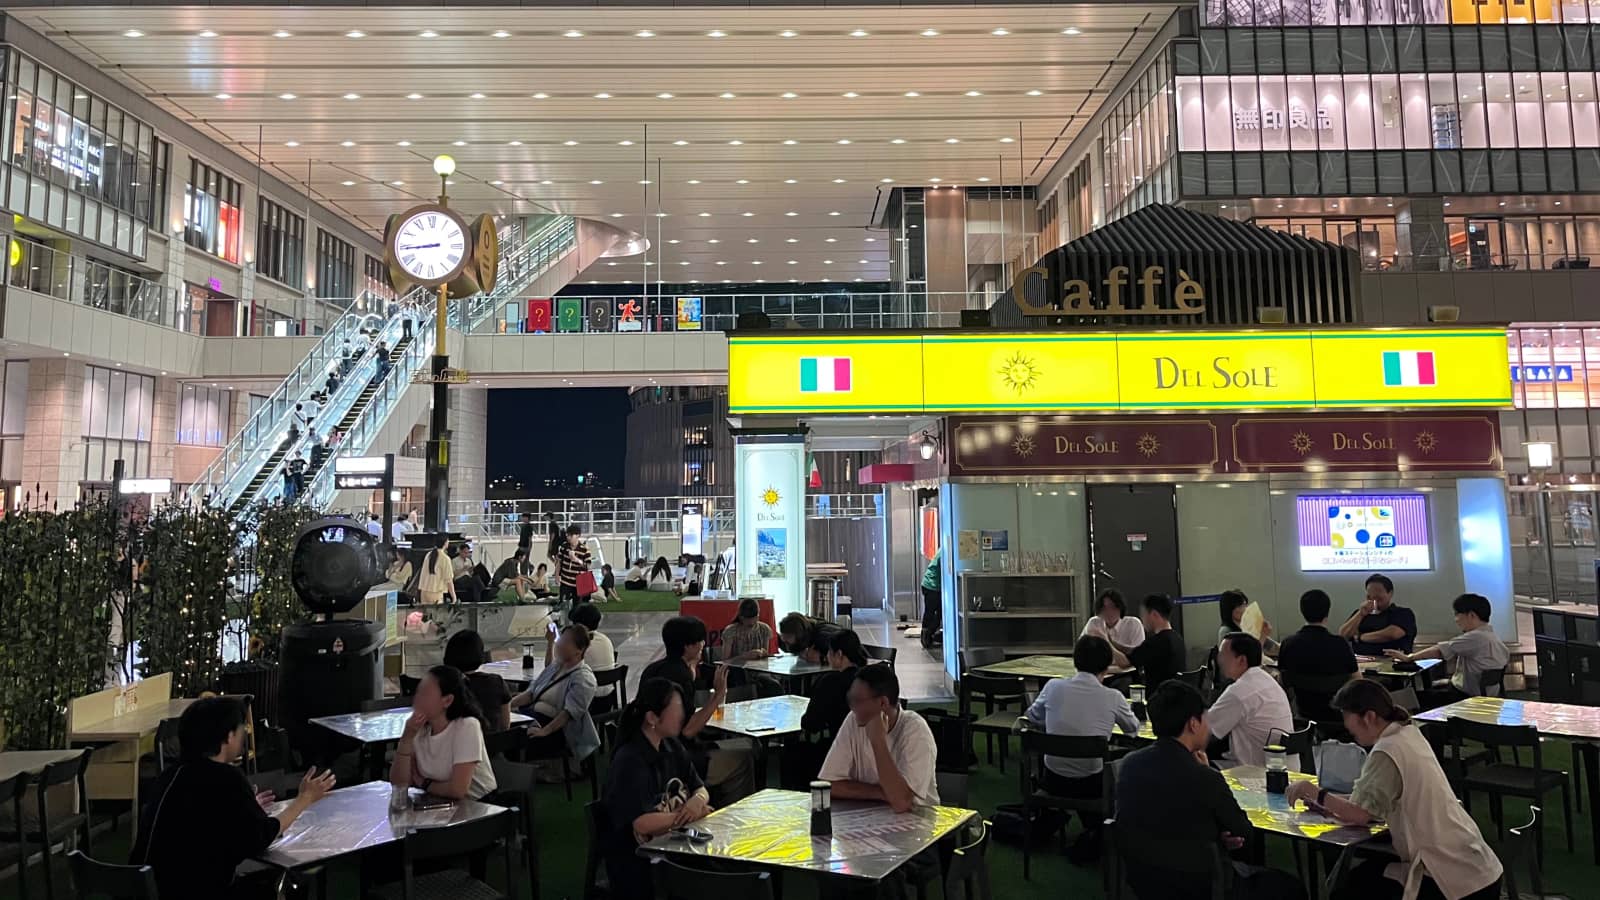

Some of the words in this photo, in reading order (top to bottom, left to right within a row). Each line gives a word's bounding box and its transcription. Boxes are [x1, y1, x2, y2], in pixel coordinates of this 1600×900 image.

[1234, 106, 1333, 130] 無印良品
[1013, 266, 1206, 315] Caffè
[1212, 356, 1278, 389] SOLE
